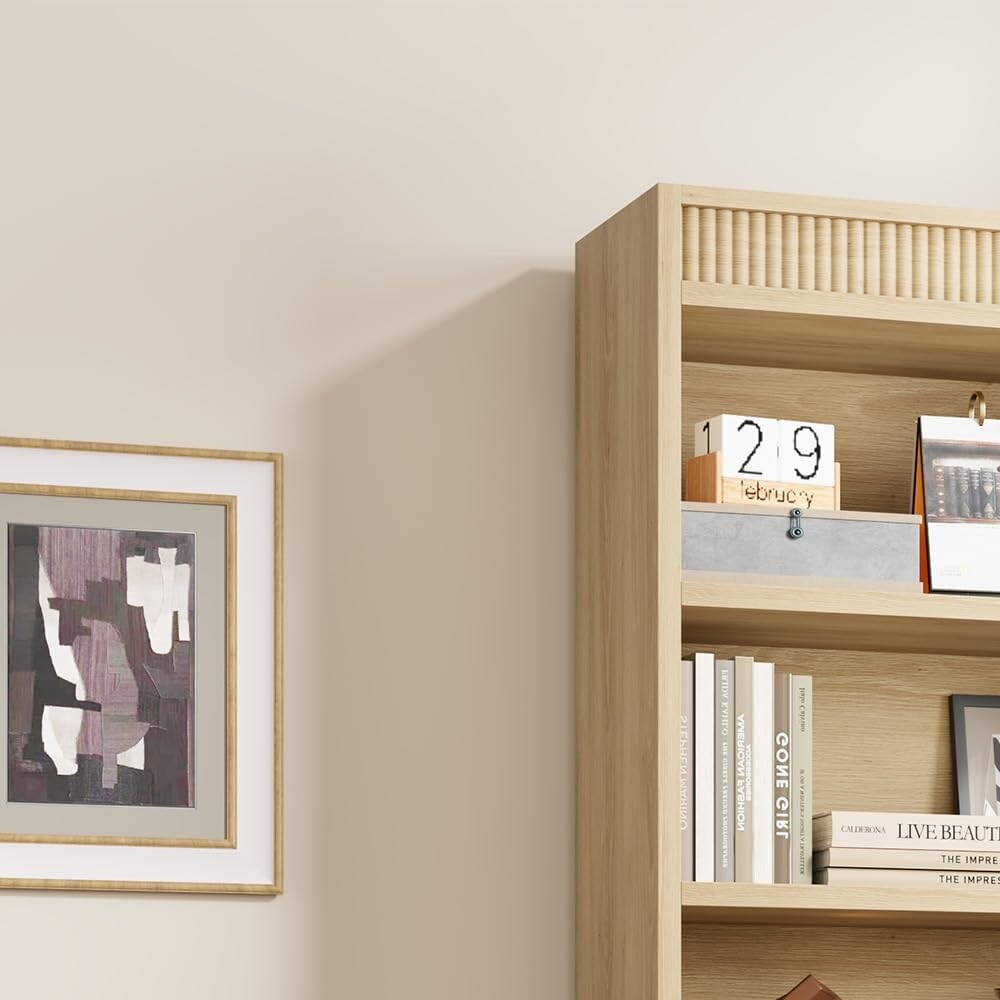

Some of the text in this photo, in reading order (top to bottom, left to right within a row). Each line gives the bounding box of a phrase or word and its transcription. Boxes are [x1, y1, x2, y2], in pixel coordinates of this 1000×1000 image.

[737, 419, 821, 480] 2 9
[896, 822, 938, 840] LIVE
[941, 855, 961, 864] THE
[939, 874, 959, 884] THE
